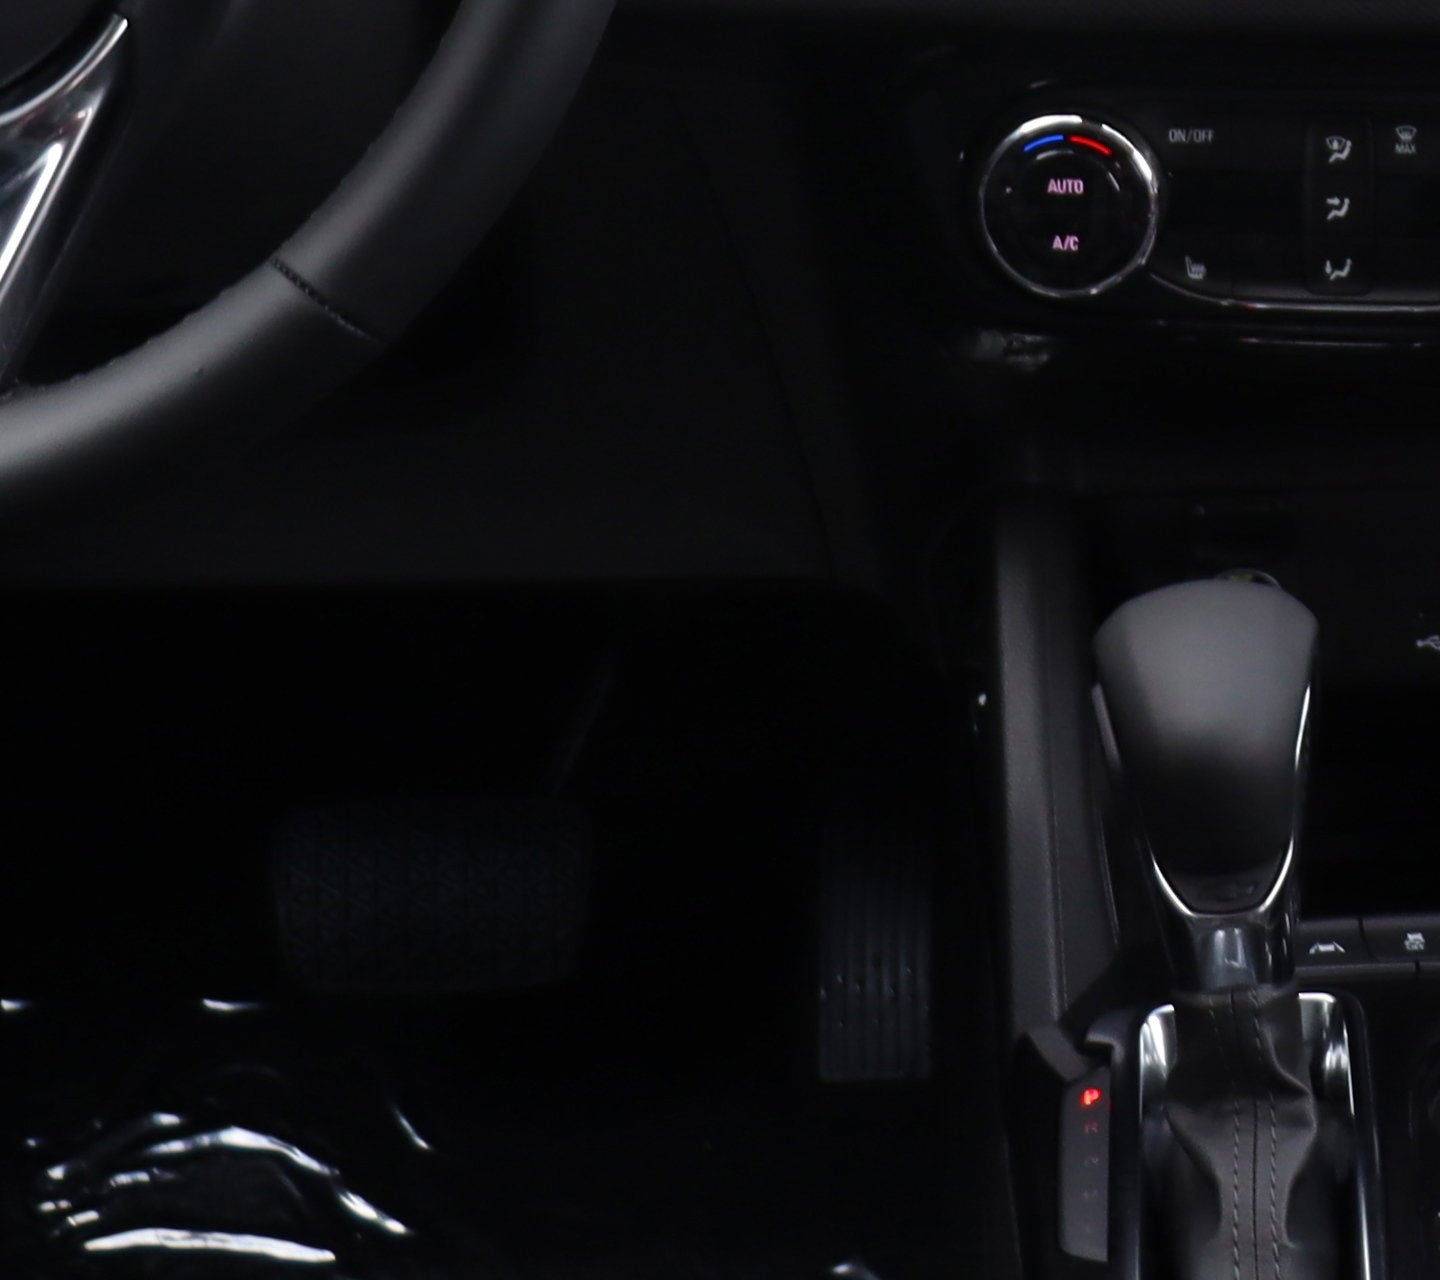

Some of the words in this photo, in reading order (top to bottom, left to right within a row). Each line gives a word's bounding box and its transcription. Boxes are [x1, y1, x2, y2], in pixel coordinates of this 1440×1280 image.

[1168, 128, 1215, 144] ON/OFF
[1395, 142, 1417, 155] MAX
[1047, 178, 1085, 195] AUTO
[1052, 235, 1080, 252] A/C
[1081, 1086, 1103, 1107] P
